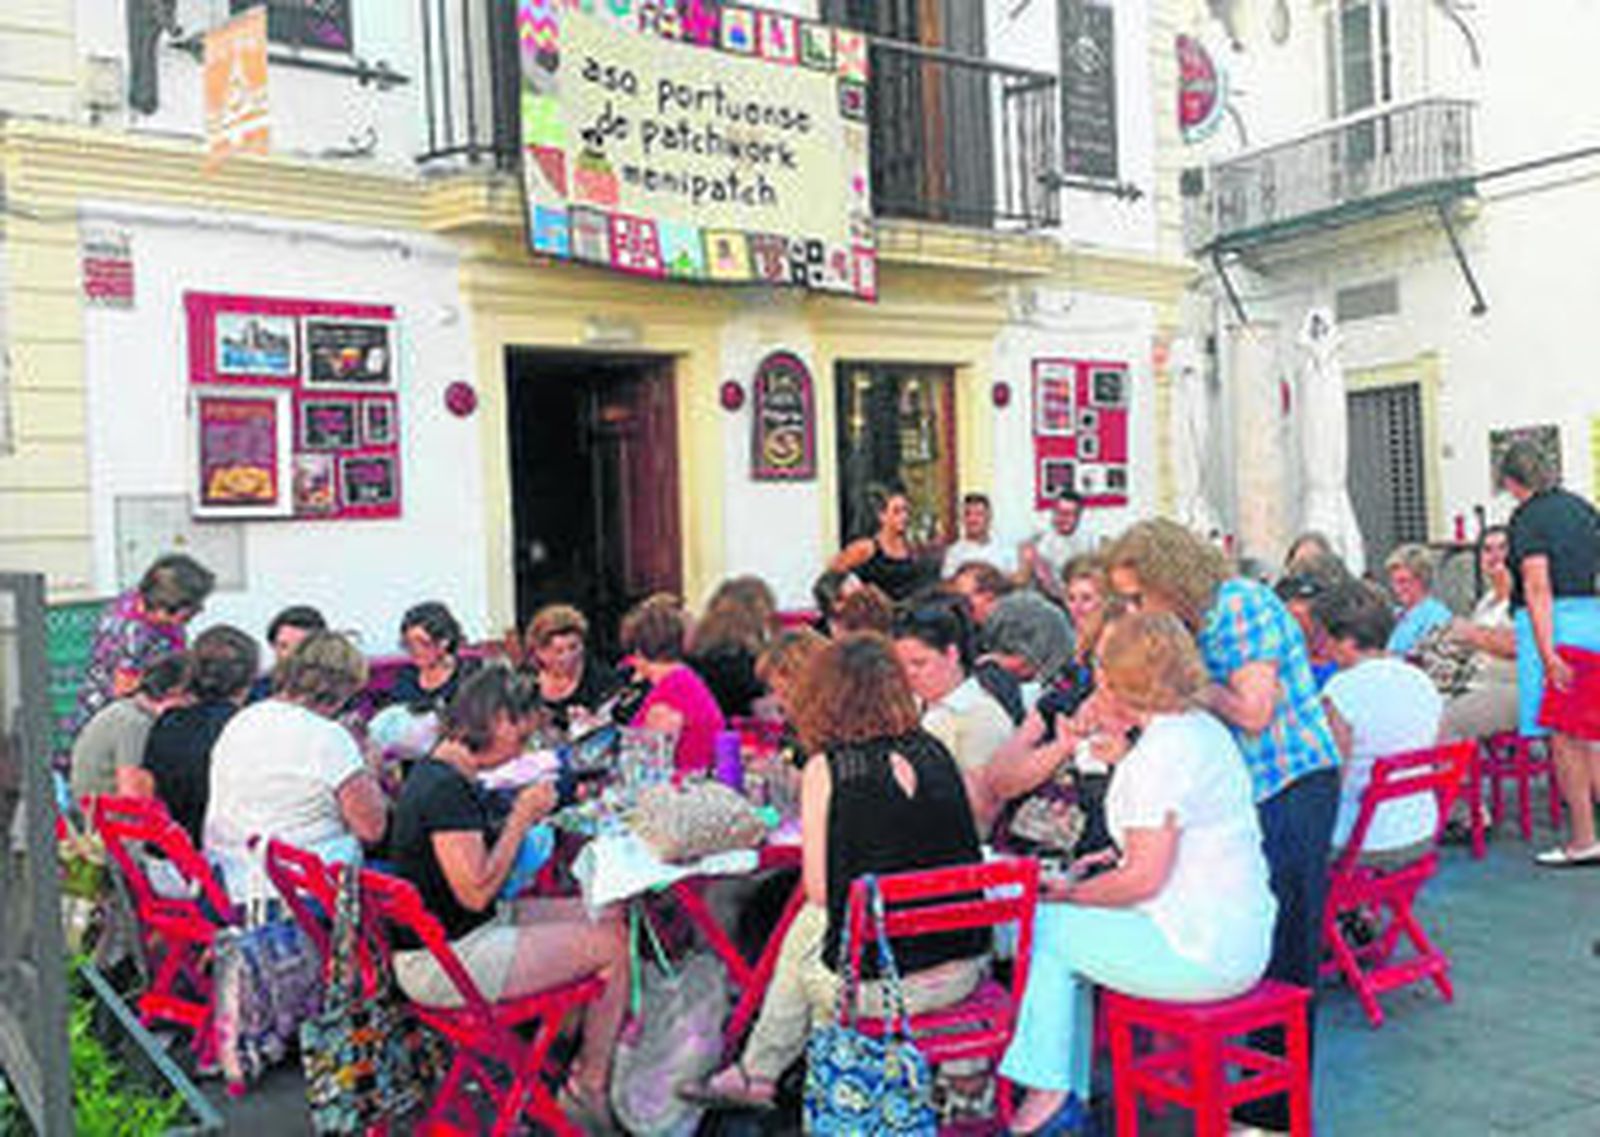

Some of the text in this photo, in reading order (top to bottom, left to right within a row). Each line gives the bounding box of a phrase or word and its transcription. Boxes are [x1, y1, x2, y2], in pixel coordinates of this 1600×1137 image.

[596, 102, 797, 169] de patchwork
[657, 79, 810, 134] portuense
